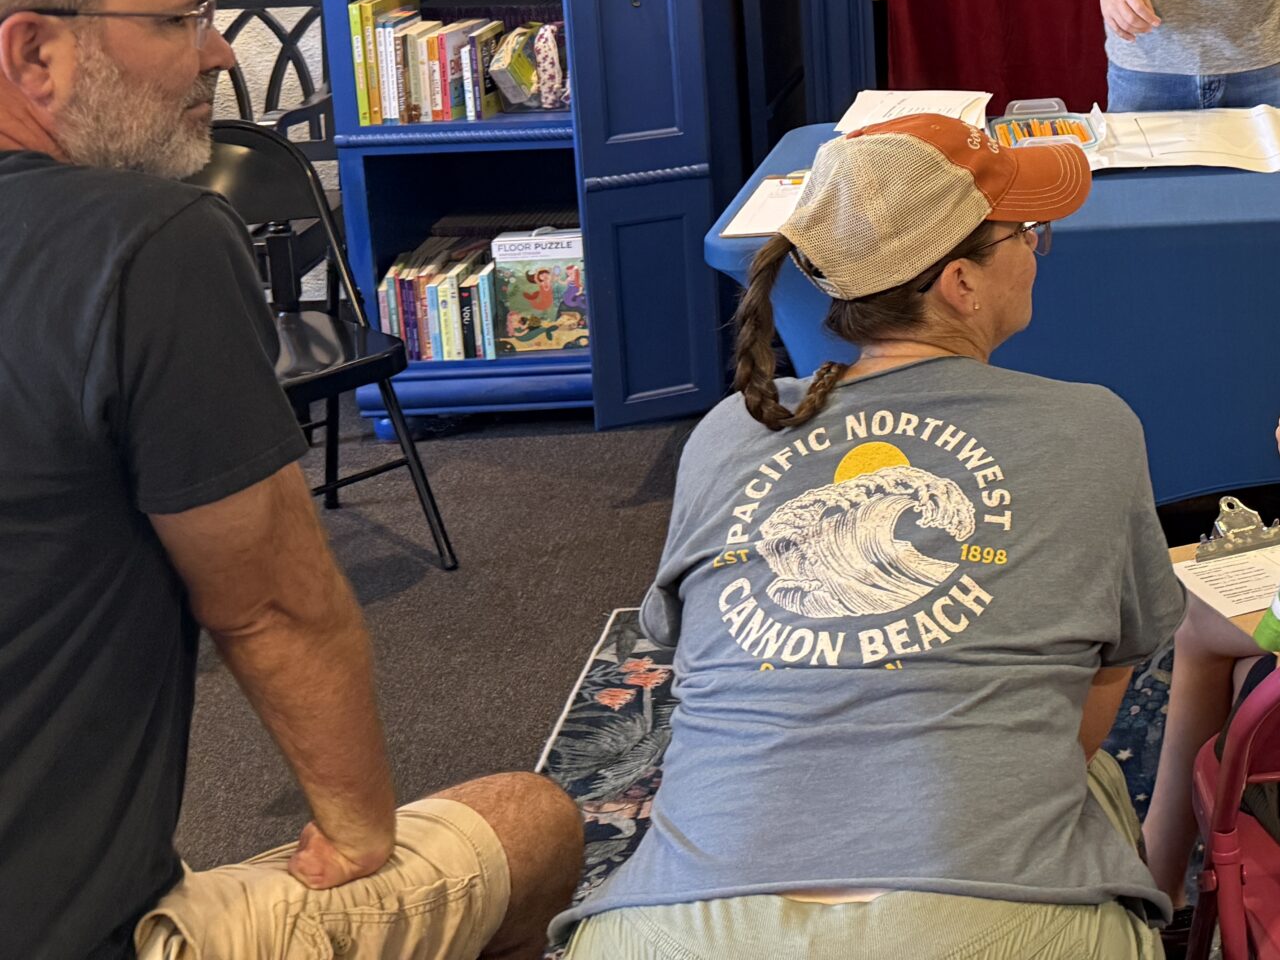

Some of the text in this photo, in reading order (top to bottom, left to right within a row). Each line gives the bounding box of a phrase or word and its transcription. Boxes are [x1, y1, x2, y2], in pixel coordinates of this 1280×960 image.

[497, 241, 573, 252] FLOOR PUZZLE
[726, 410, 1012, 545] PACIFIC NORTHWEST
[960, 543, 1008, 565] 1898
[718, 574, 995, 667] CANNON BEACH
